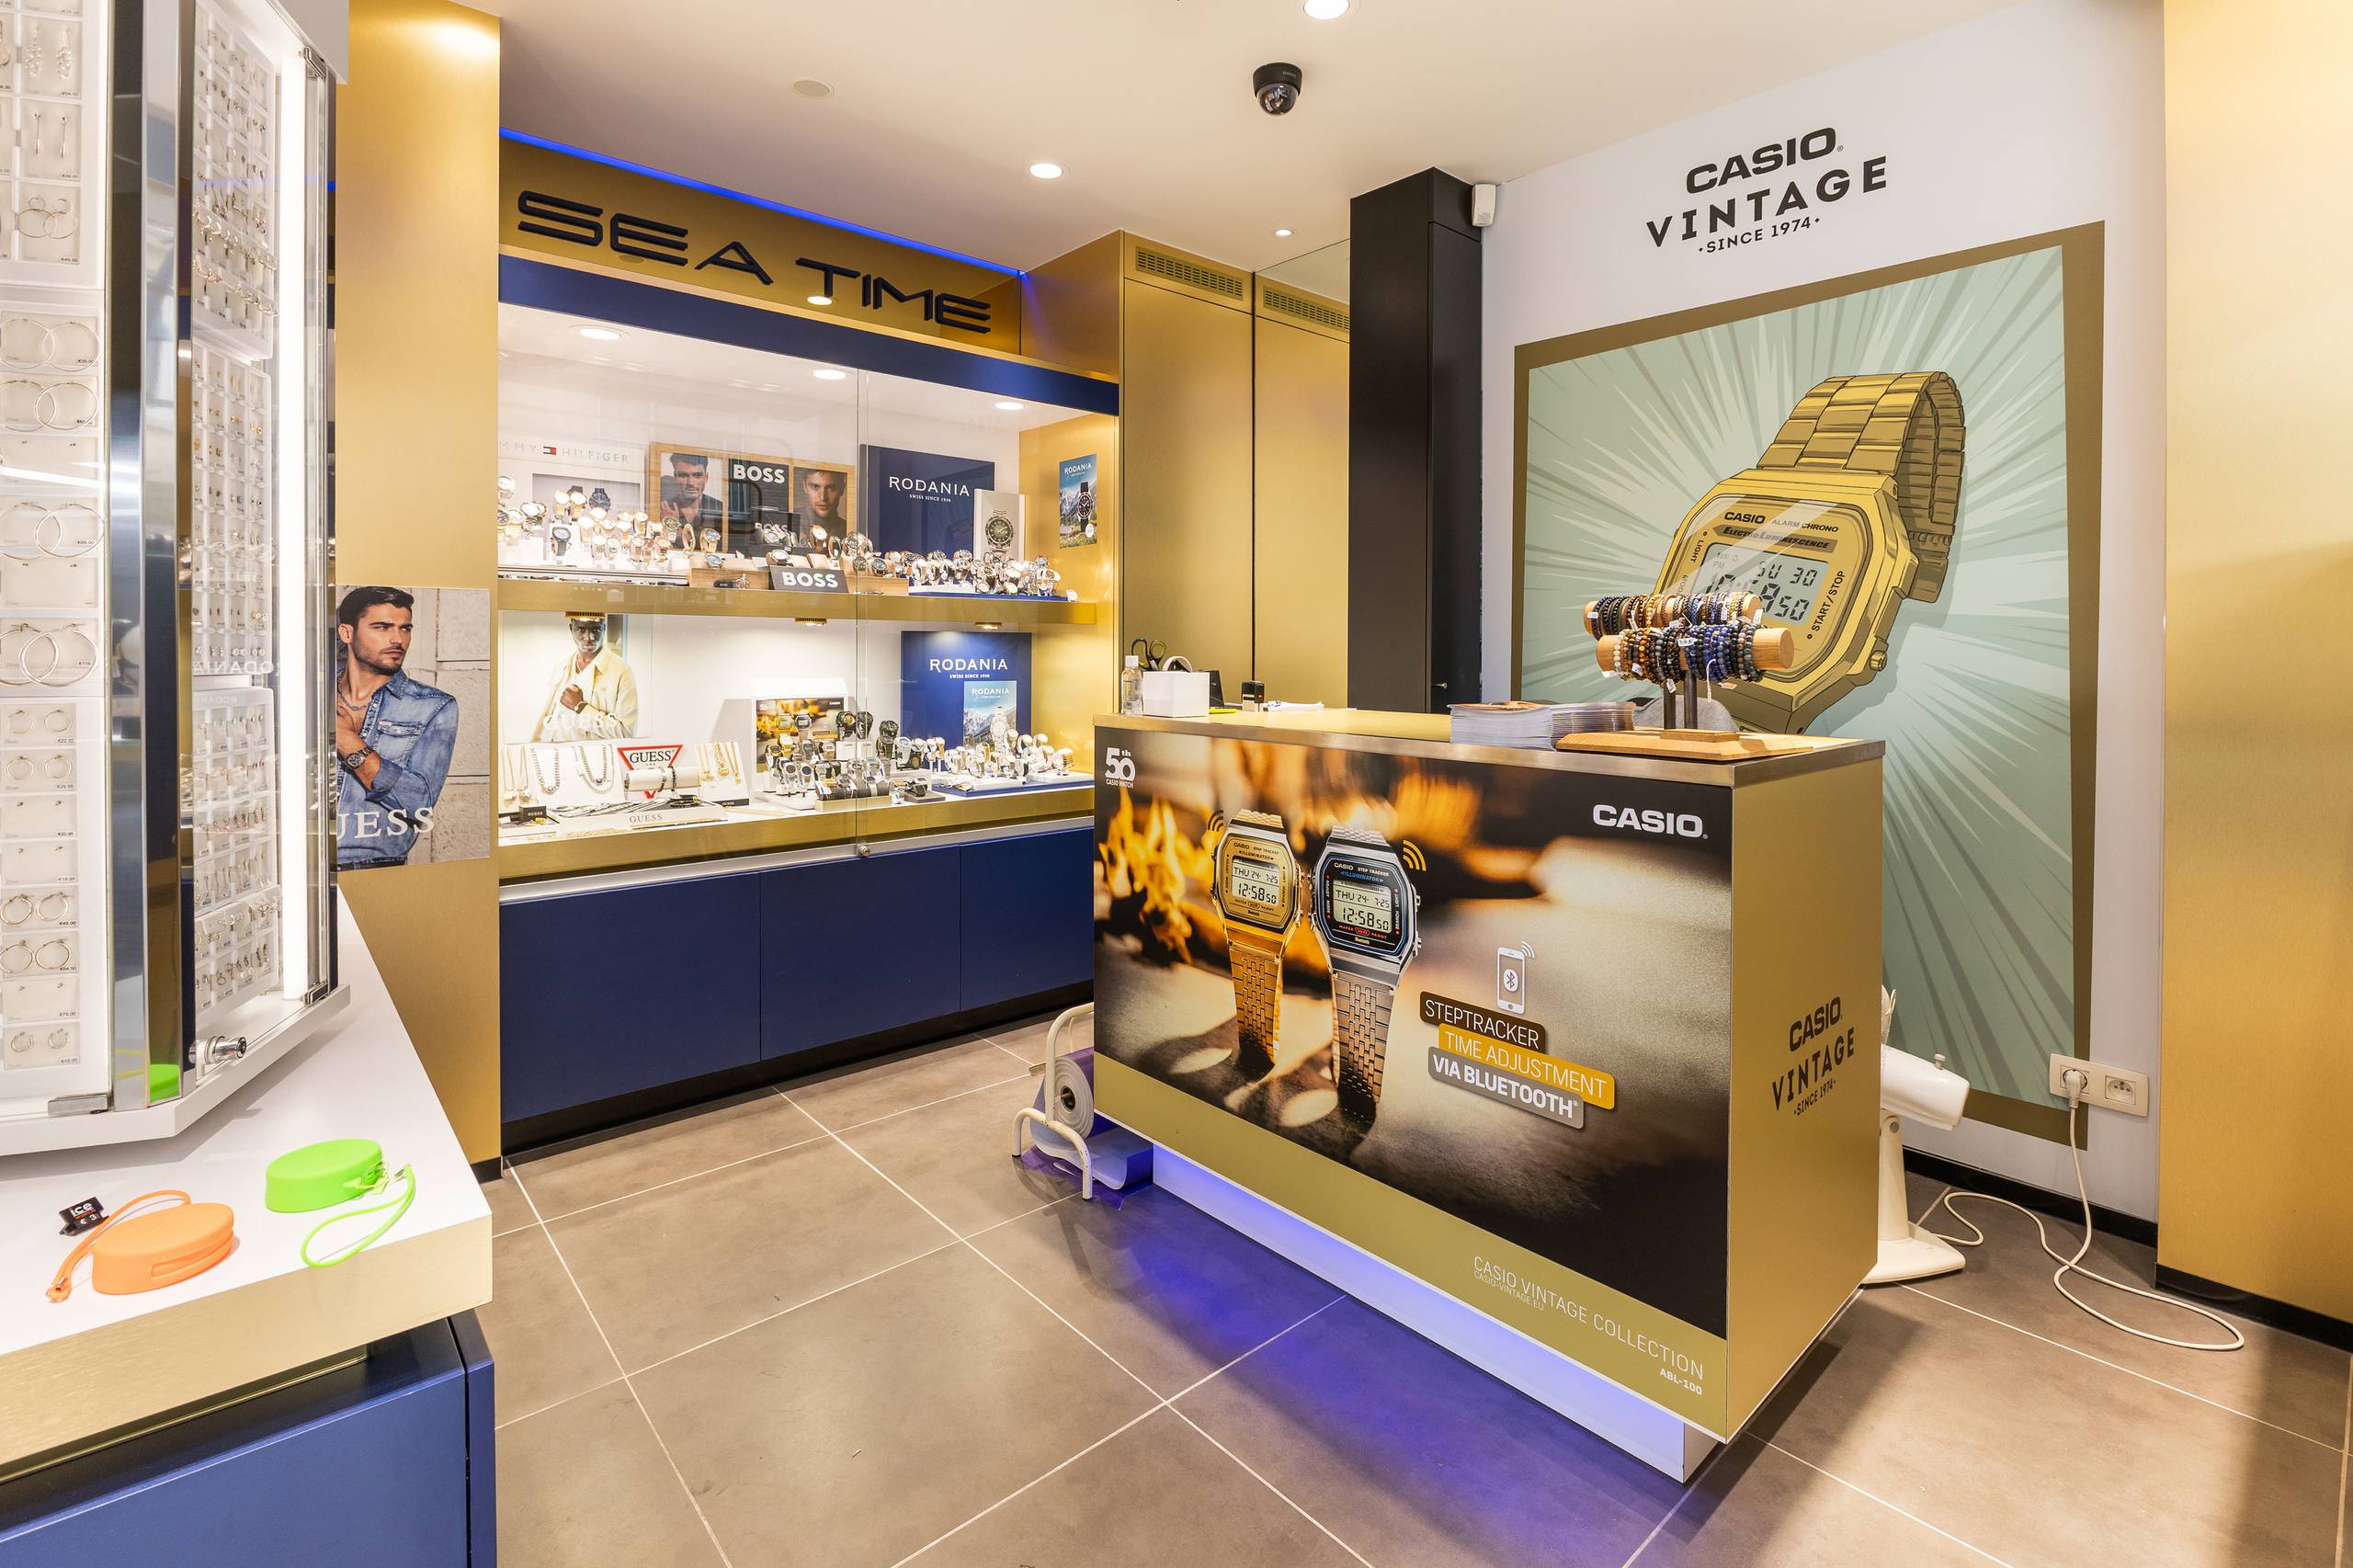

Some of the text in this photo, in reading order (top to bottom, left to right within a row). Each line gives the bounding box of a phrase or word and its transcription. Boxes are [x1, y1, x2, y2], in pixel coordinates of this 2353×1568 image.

[1686, 127, 1836, 194] CASIO
[1646, 155, 1887, 247] VINTAGE
[1770, 216, 1811, 238] 1974
[517, 190, 992, 334] SEA TIME
[499, 441, 631, 463] MMY HILFIGER
[733, 463, 785, 483] BOSS
[1064, 462, 1092, 474] RODANIA
[889, 476, 970, 496] RODANIA
[1724, 511, 1766, 524] CASIO
[1771, 518, 1839, 533] ALARM CHRONO
[1690, 540, 1705, 563] LIGHT
[781, 571, 838, 588] BOSS
[1790, 566, 1818, 586] 30
[1811, 570, 1846, 632] START/STOP
[929, 658, 1008, 673] RODANIA
[972, 687, 1009, 696] RODANIA
[630, 750, 672, 764] GUESS
[336, 807, 435, 840] ESS
[629, 813, 663, 824] GUESS
[1593, 804, 1703, 838] CASIO
[1233, 842, 1250, 850] CASIO
[1233, 866, 1250, 877] THU
[1334, 862, 1354, 870] CASIO
[1370, 869, 1390, 877] TRACKER
[1343, 871, 1381, 882] ILLUMINATOR
[1238, 882, 1277, 904] 12:58 50
[1336, 890, 1355, 901] THU
[1343, 907, 1389, 931] 12:58 50
[1425, 999, 1540, 1050] STEPTRACKER
[1789, 996, 1841, 1052] CASIO
[1444, 1030, 1608, 1099] TIME ADJUSTMENT
[1772, 1027, 1855, 1111] VINTAGE
[1433, 1054, 1574, 1119] VIA BLUETOOTH
[70, 1202, 94, 1217] ice
[1474, 1256, 1704, 1381] CASIO VINTAGE COLLECTION
[1659, 1367, 1703, 1395] ABL-100
